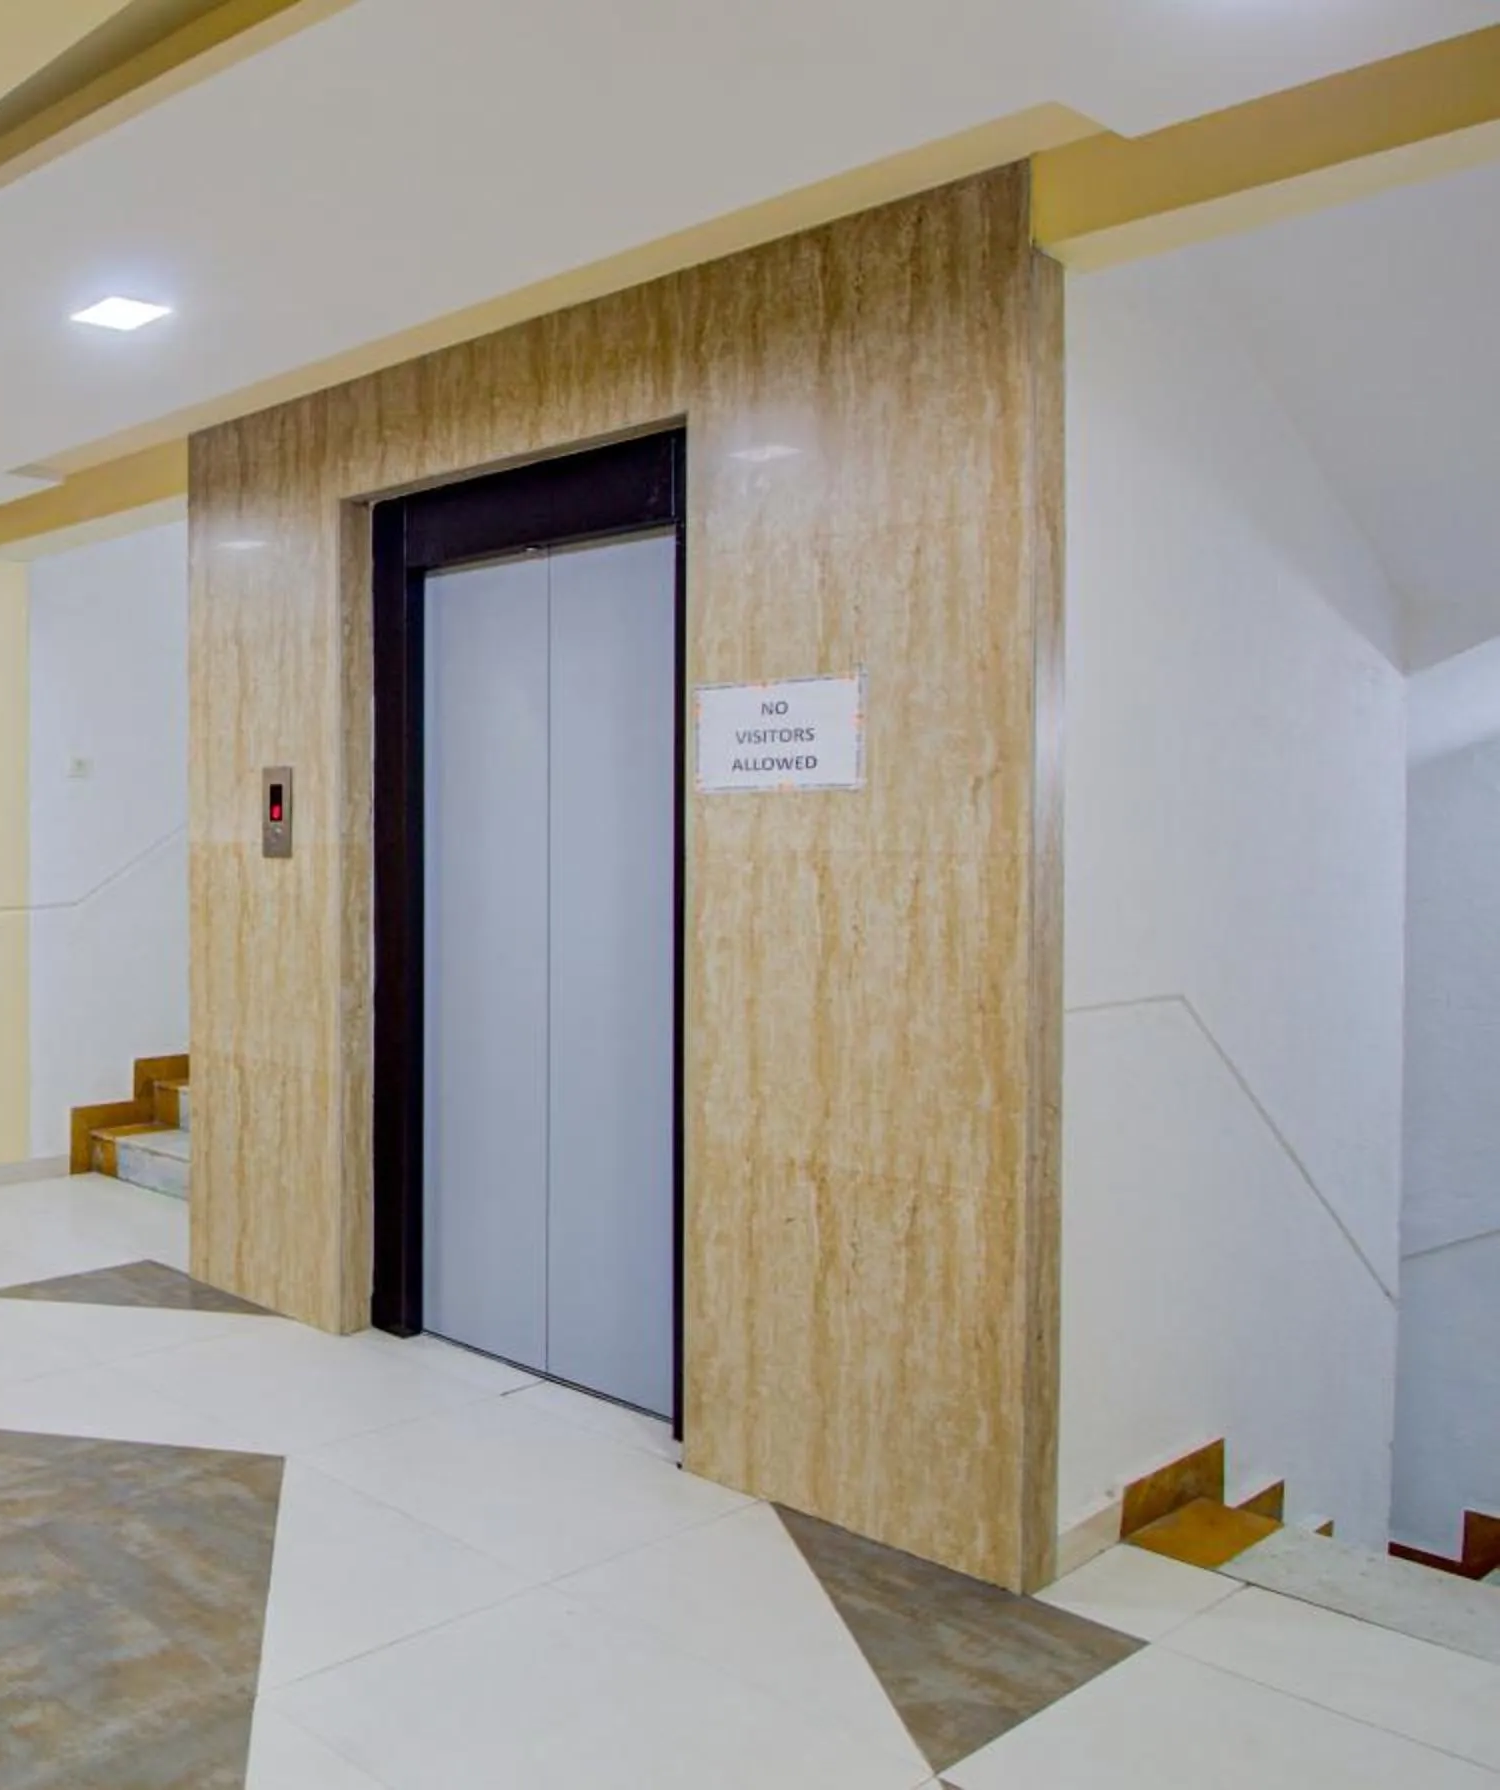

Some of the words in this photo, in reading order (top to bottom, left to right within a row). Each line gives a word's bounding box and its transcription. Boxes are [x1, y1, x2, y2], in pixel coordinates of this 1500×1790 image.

[761, 701, 789, 716] NO
[735, 727, 816, 745] VISITORS
[731, 755, 818, 772] ALLOWED
